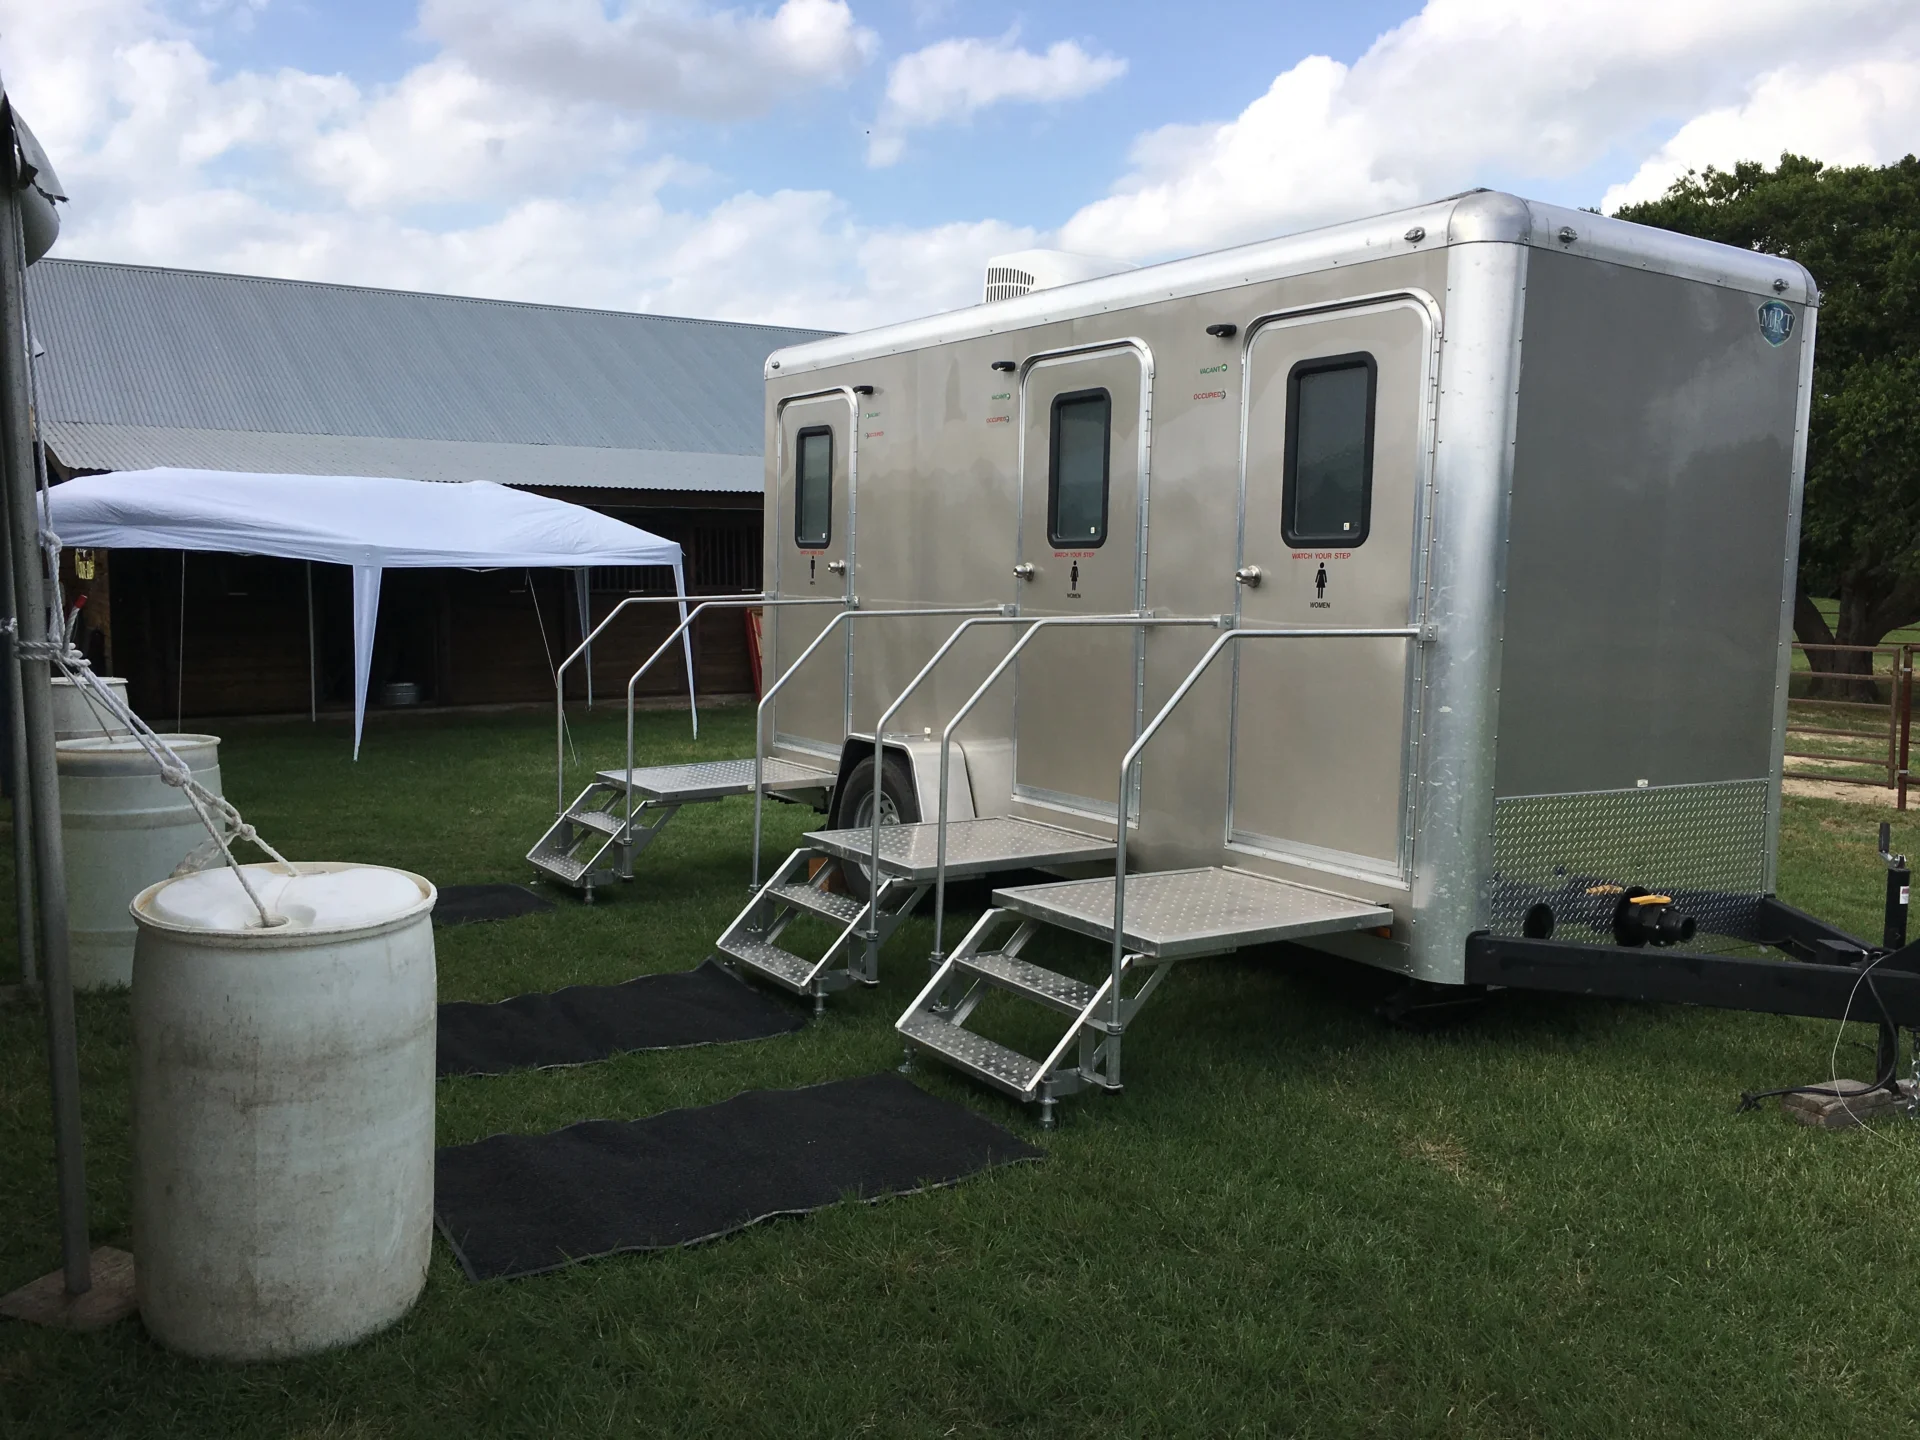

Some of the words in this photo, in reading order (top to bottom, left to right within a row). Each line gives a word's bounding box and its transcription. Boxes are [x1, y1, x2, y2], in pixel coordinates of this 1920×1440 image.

[1760, 307, 1794, 334] MRT
[1199, 365, 1221, 375] VACANT
[1193, 391, 1222, 400] OCCUPIED
[1291, 552, 1313, 560] WATCH
[1314, 552, 1332, 560] YOUR
[1334, 552, 1351, 560] STEP
[1309, 601, 1331, 609] WOMEN
